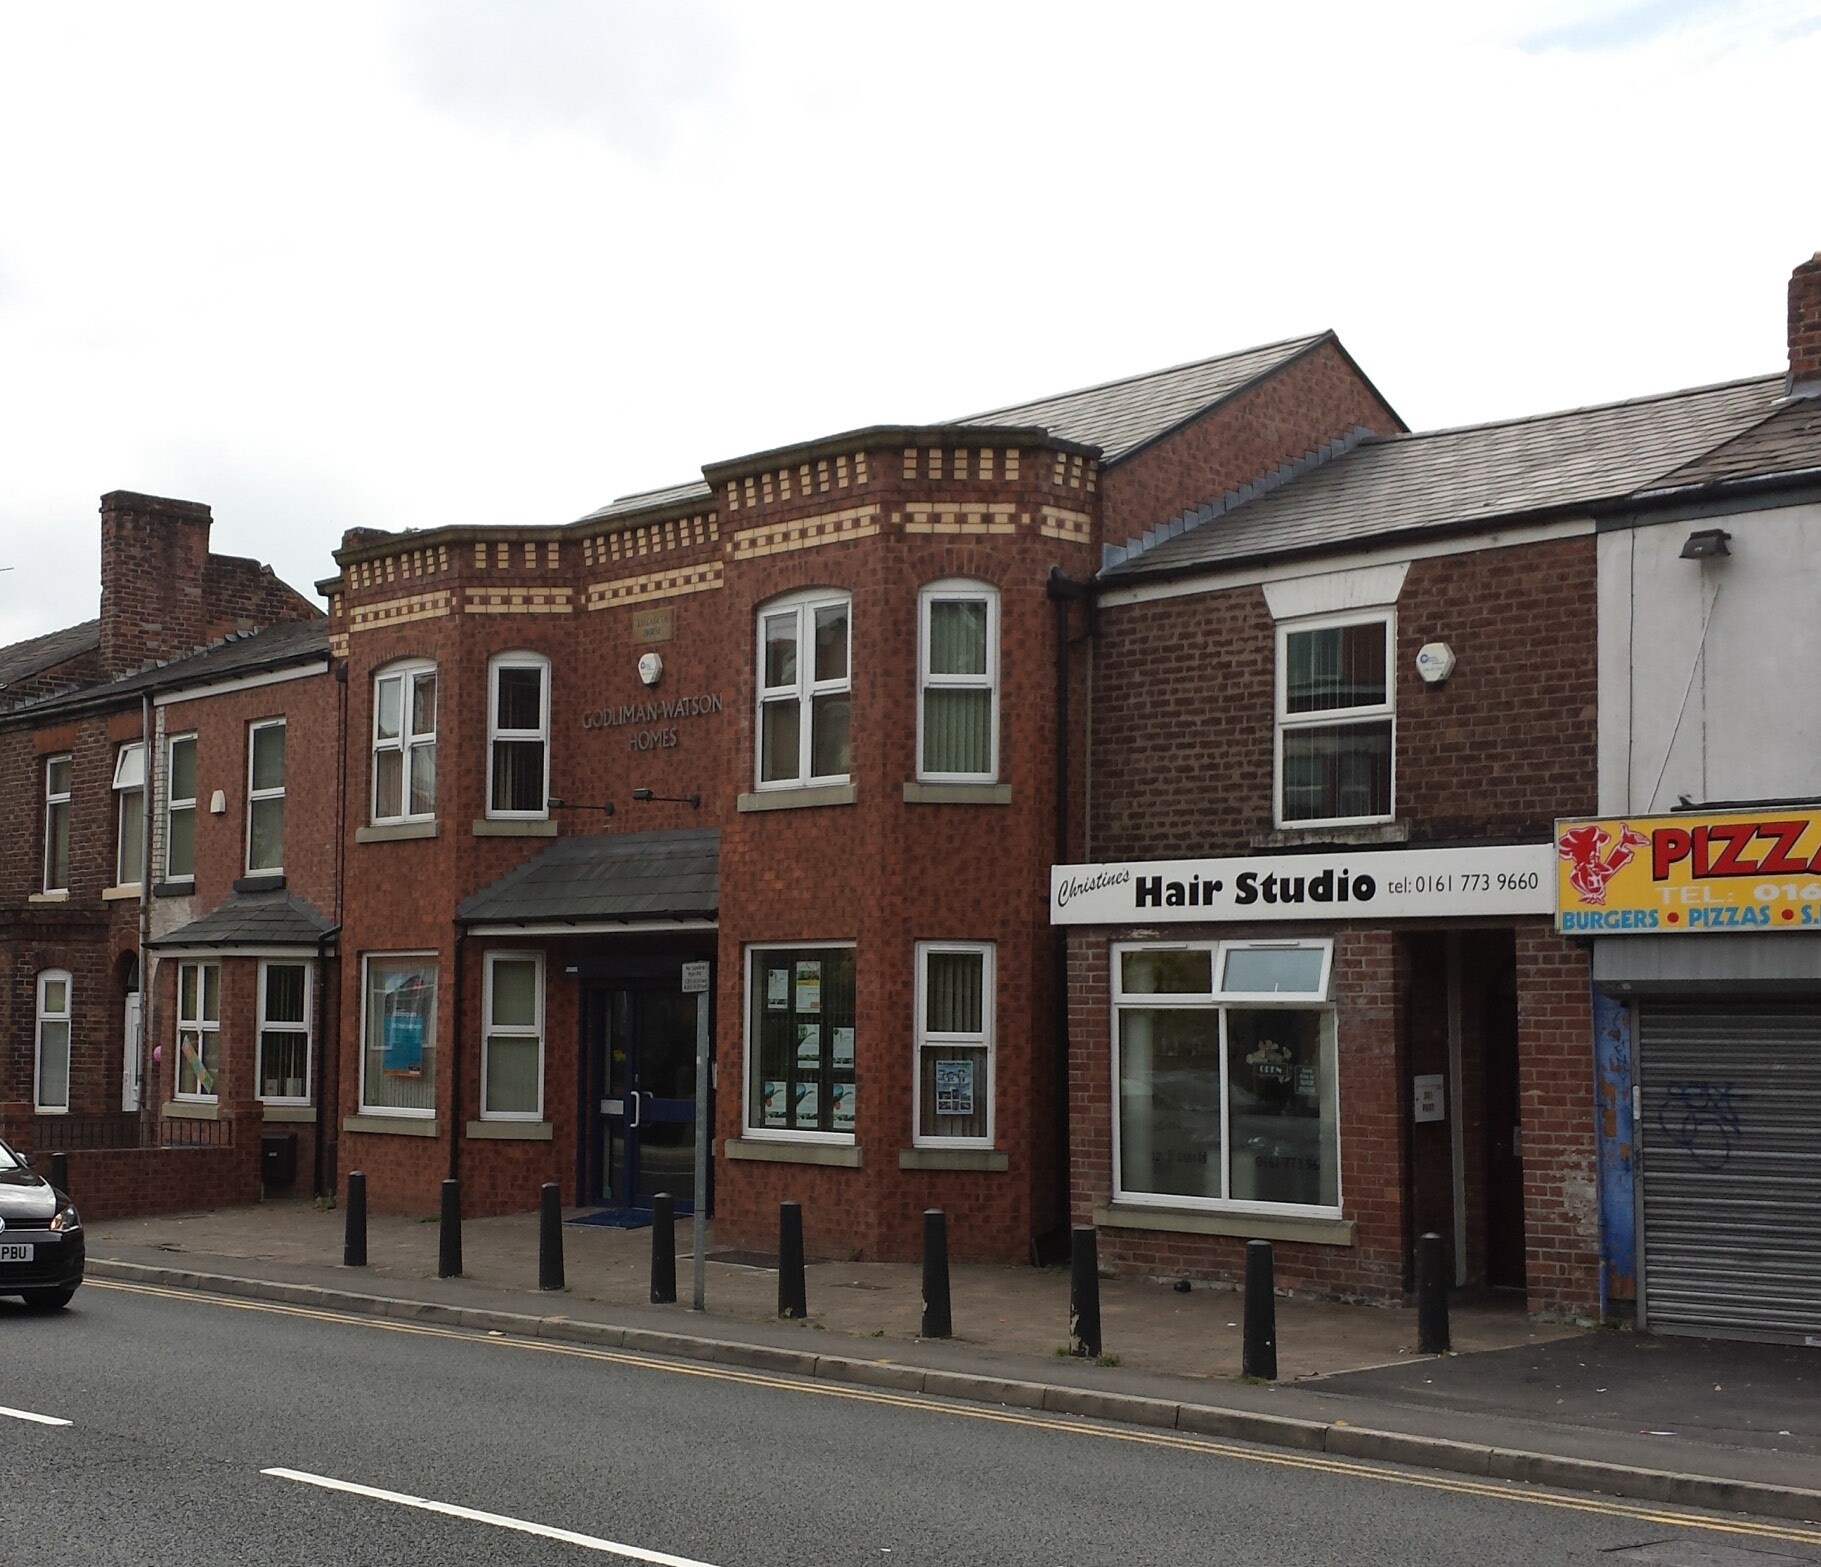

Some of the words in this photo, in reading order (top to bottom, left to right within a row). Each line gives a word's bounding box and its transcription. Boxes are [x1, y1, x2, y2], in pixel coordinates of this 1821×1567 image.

[630, 727, 677, 750] HOMES
[1134, 873, 1223, 908] Hair
[1235, 868, 1376, 905] Studio
[1388, 878, 1412, 894] tel:
[1415, 875, 1453, 893] 0161
[1460, 873, 1491, 892] 773
[1496, 872, 1539, 890] 9660
[1654, 884, 1734, 904] TEL:
[1562, 908, 1659, 930] BURGERS
[1688, 905, 1770, 927] PIZZAS
[1801, 904, 1821, 924] S.
[1, 1246, 27, 1259] PBU
